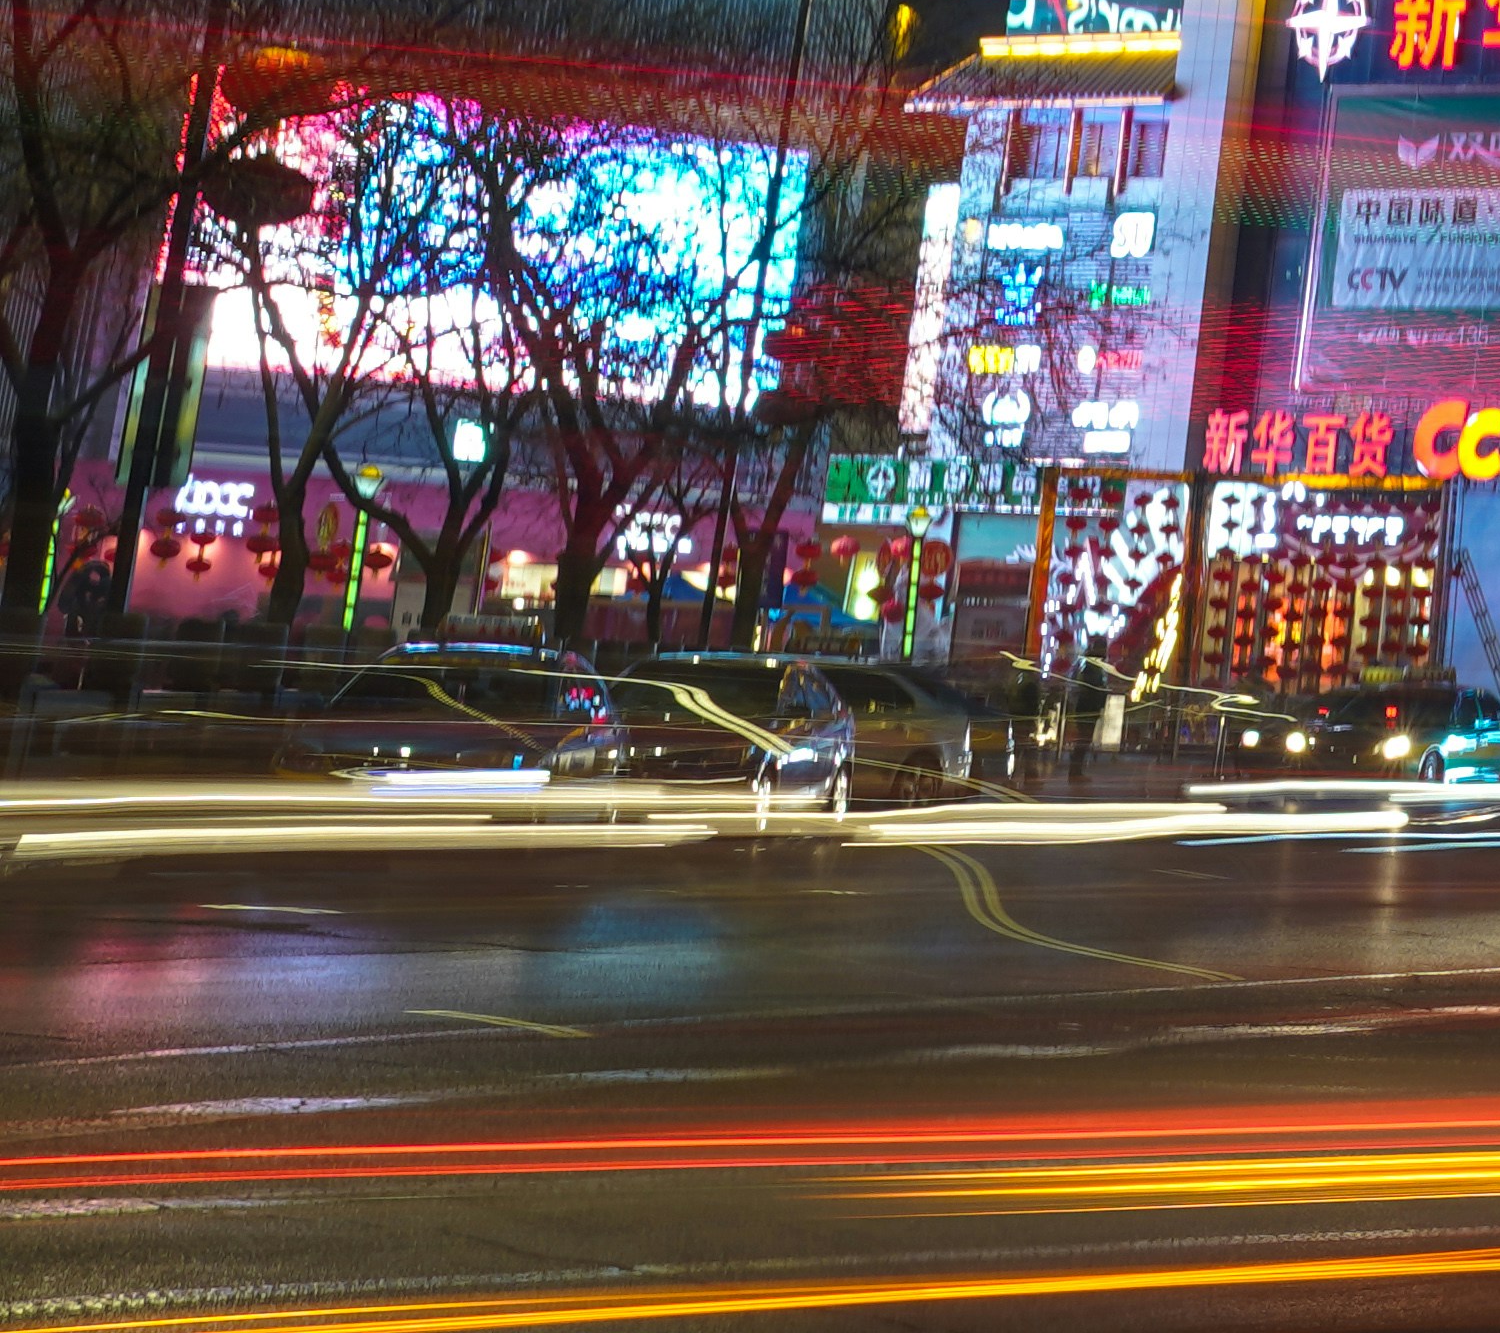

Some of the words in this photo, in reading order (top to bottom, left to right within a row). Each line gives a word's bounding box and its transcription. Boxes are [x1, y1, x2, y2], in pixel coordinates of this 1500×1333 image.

[1347, 267, 1409, 292] CCTV
[1202, 408, 1394, 477] 新华百货
